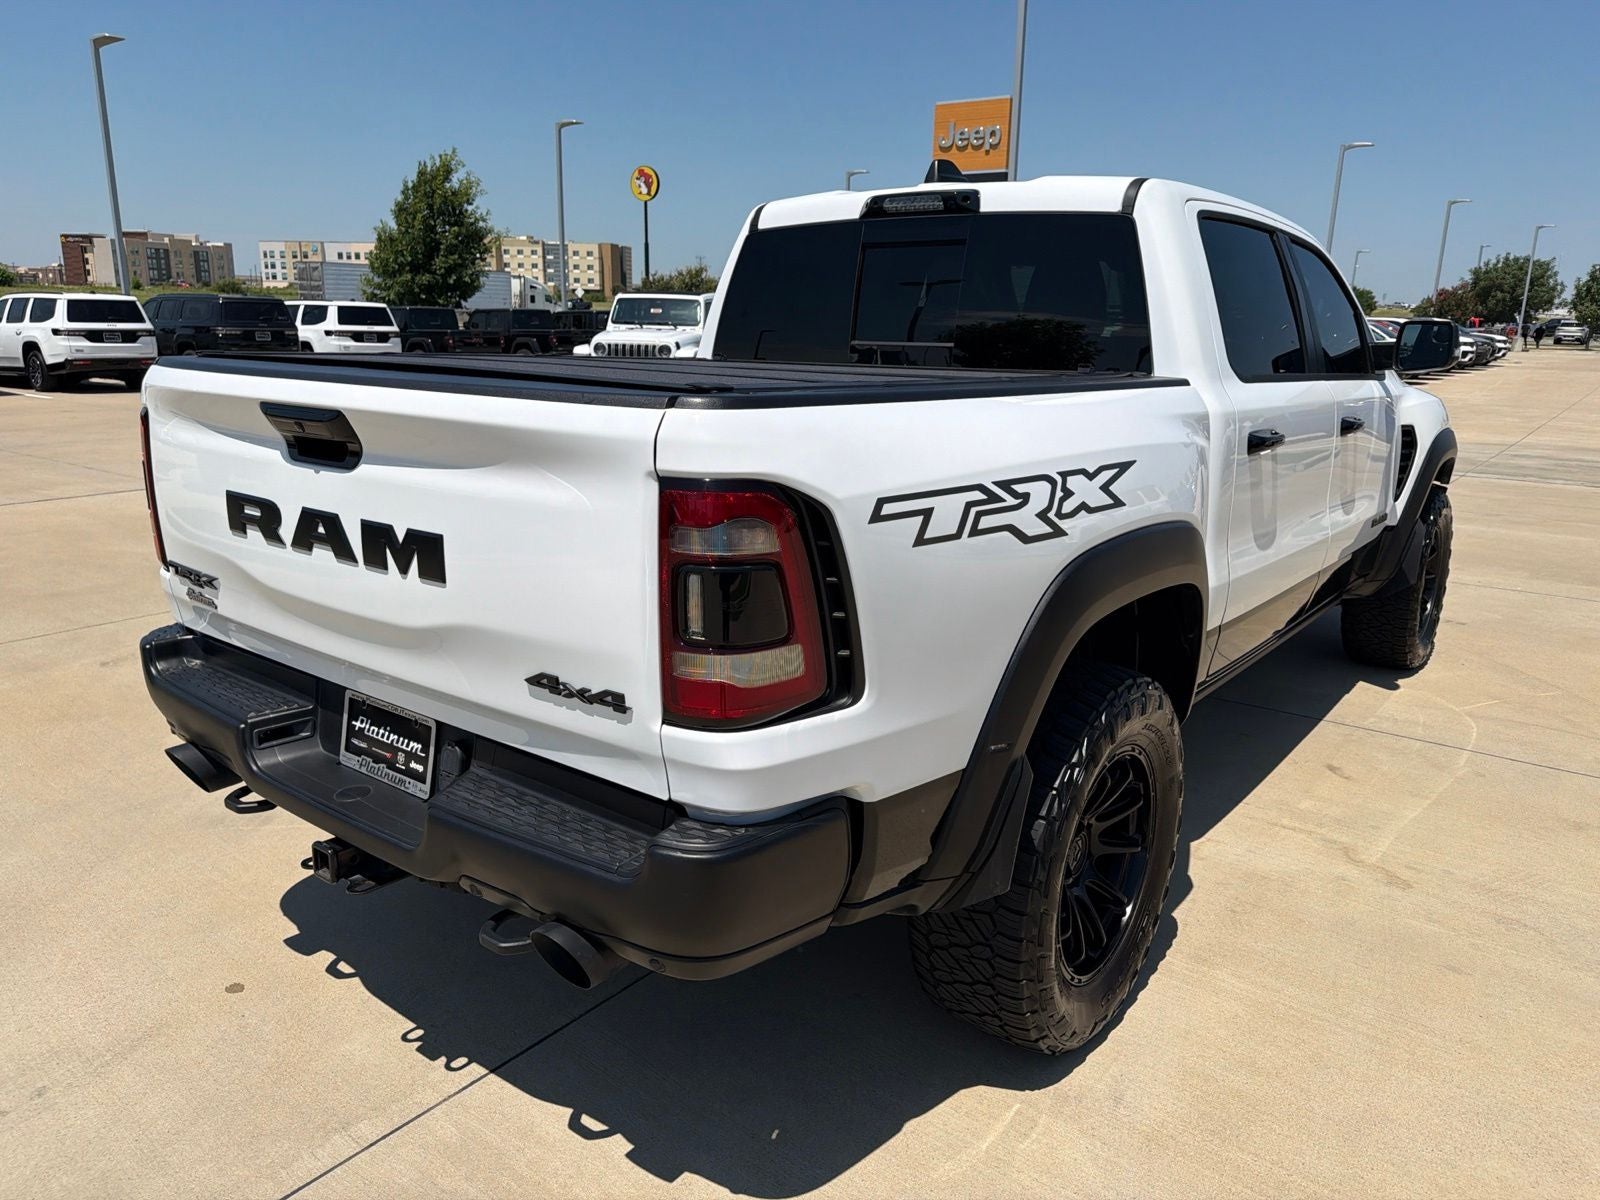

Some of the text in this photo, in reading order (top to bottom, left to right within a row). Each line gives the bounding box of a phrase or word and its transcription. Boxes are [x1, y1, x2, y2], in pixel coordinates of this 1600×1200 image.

[938, 121, 1002, 153] Jeep
[868, 460, 1137, 548] TRX
[226, 490, 447, 586] RAM
[524, 672, 632, 714] 4x4
[352, 716, 425, 757] Platinum
[359, 756, 410, 790] Platinum
[409, 760, 424, 773] Jeep
